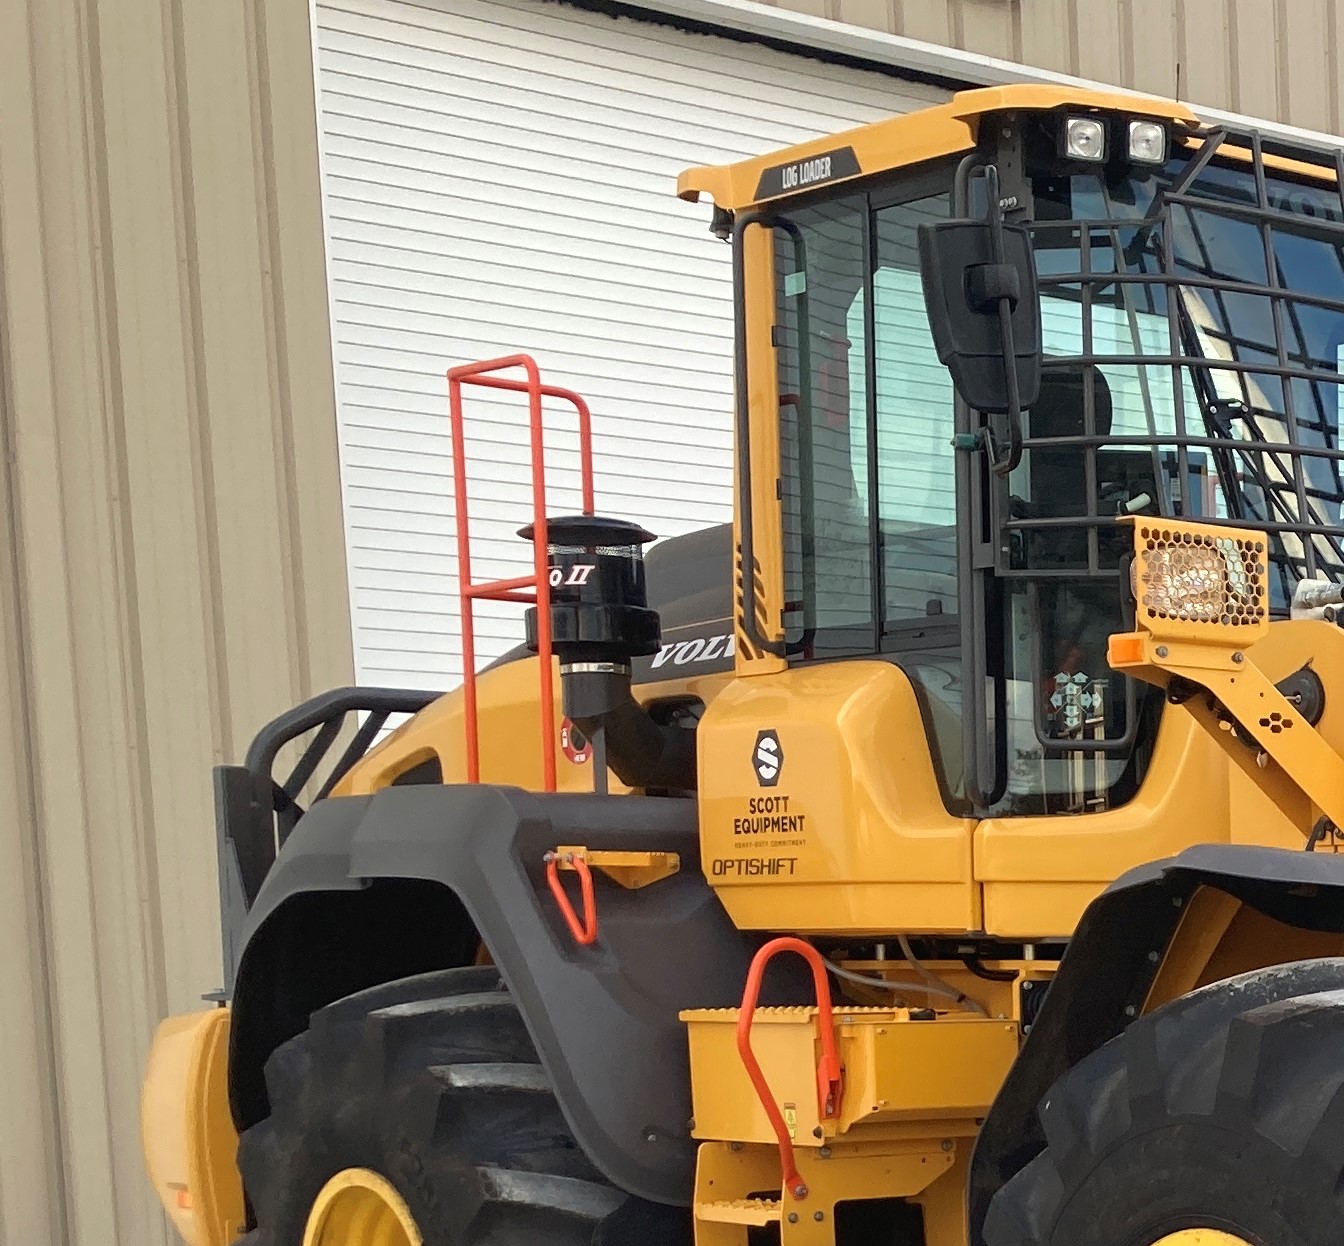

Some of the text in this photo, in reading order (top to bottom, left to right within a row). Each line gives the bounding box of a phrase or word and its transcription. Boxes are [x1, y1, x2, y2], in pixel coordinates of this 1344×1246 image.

[782, 156, 832, 189] LOG LOADER
[749, 795, 790, 814] SCOTT
[733, 815, 806, 835] EQUIPMENT
[712, 857, 799, 876] OPTISHIFT
